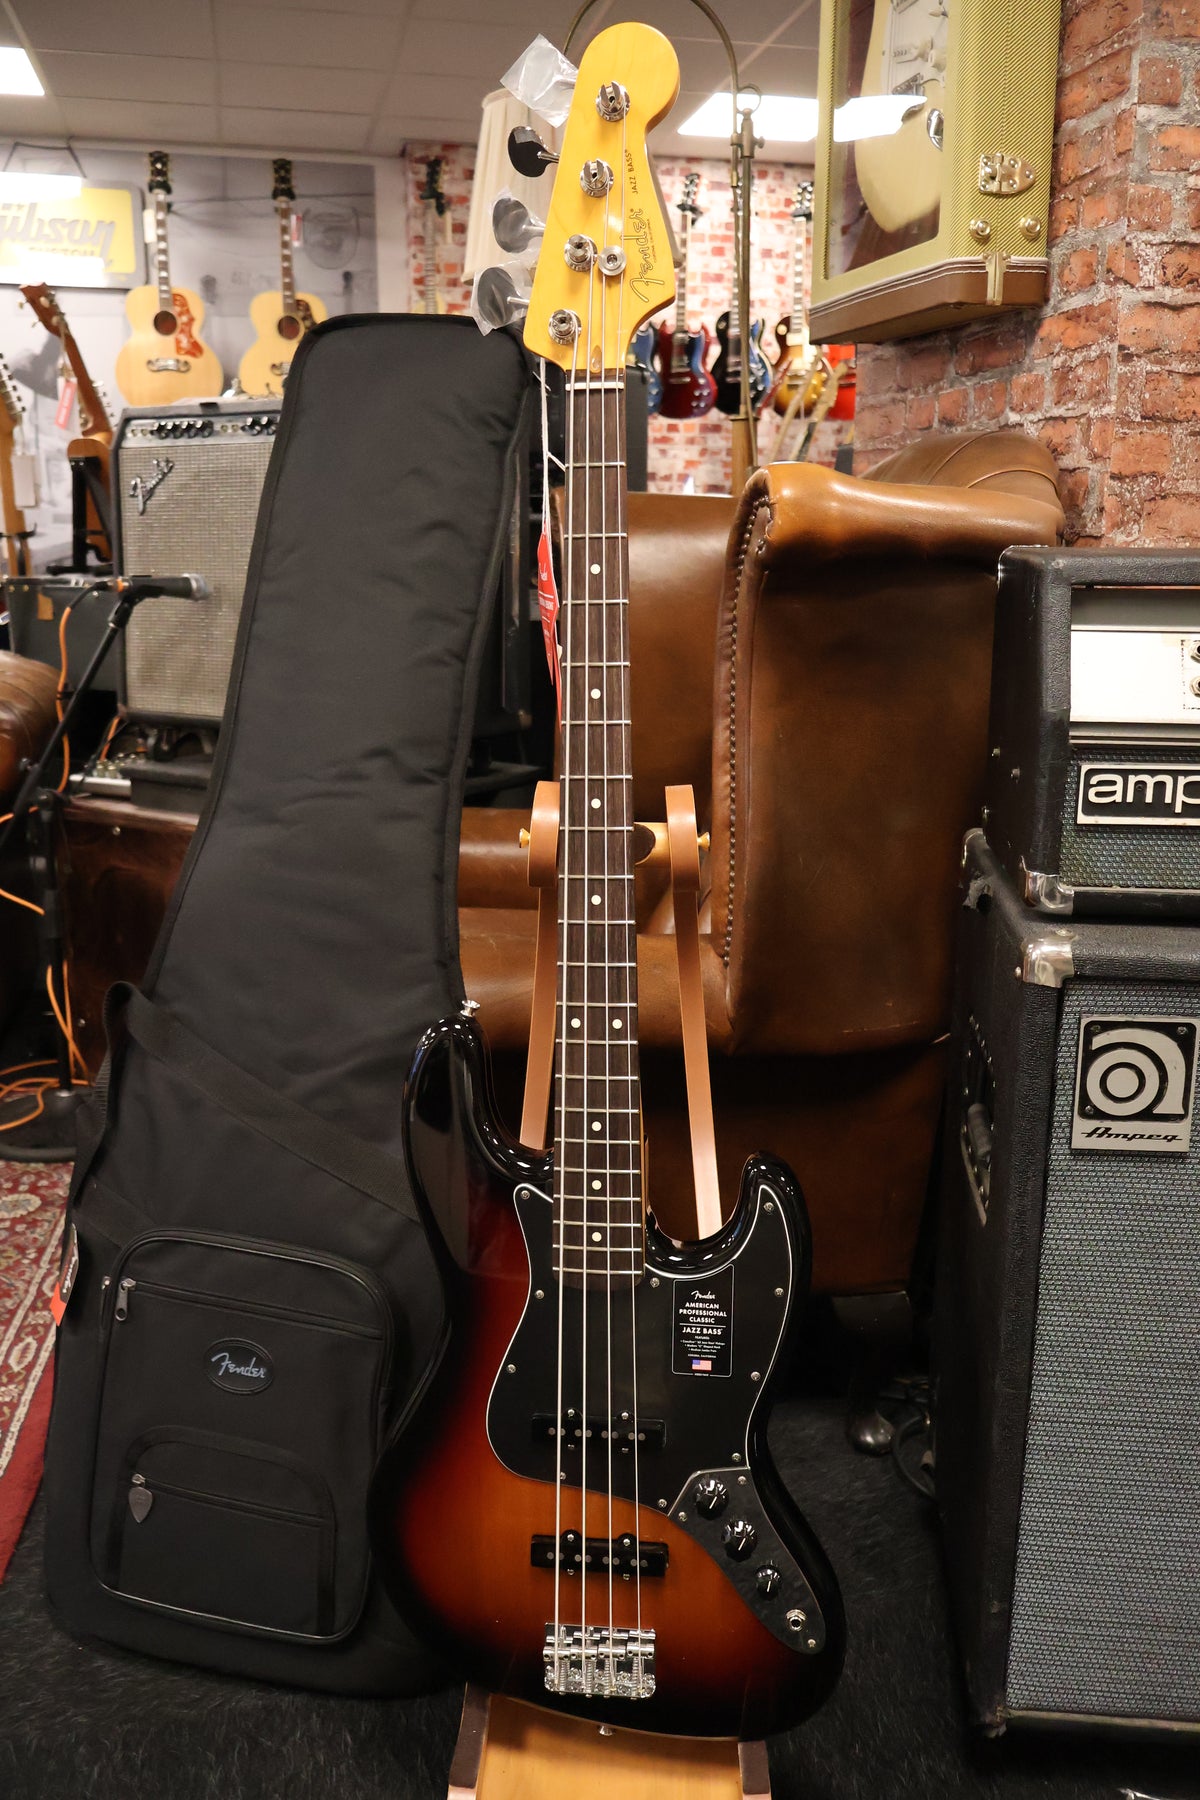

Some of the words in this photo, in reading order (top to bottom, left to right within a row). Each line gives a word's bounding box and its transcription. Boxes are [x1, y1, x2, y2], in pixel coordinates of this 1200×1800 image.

[631, 176, 639, 194] JAZZ
[0, 202, 116, 268] ibson
[620, 208, 665, 303] Fender
[1081, 1126, 1183, 1142] Ampeg
[679, 1308, 727, 1317] PROFESSIONAL
[211, 1352, 267, 1379] Fender
